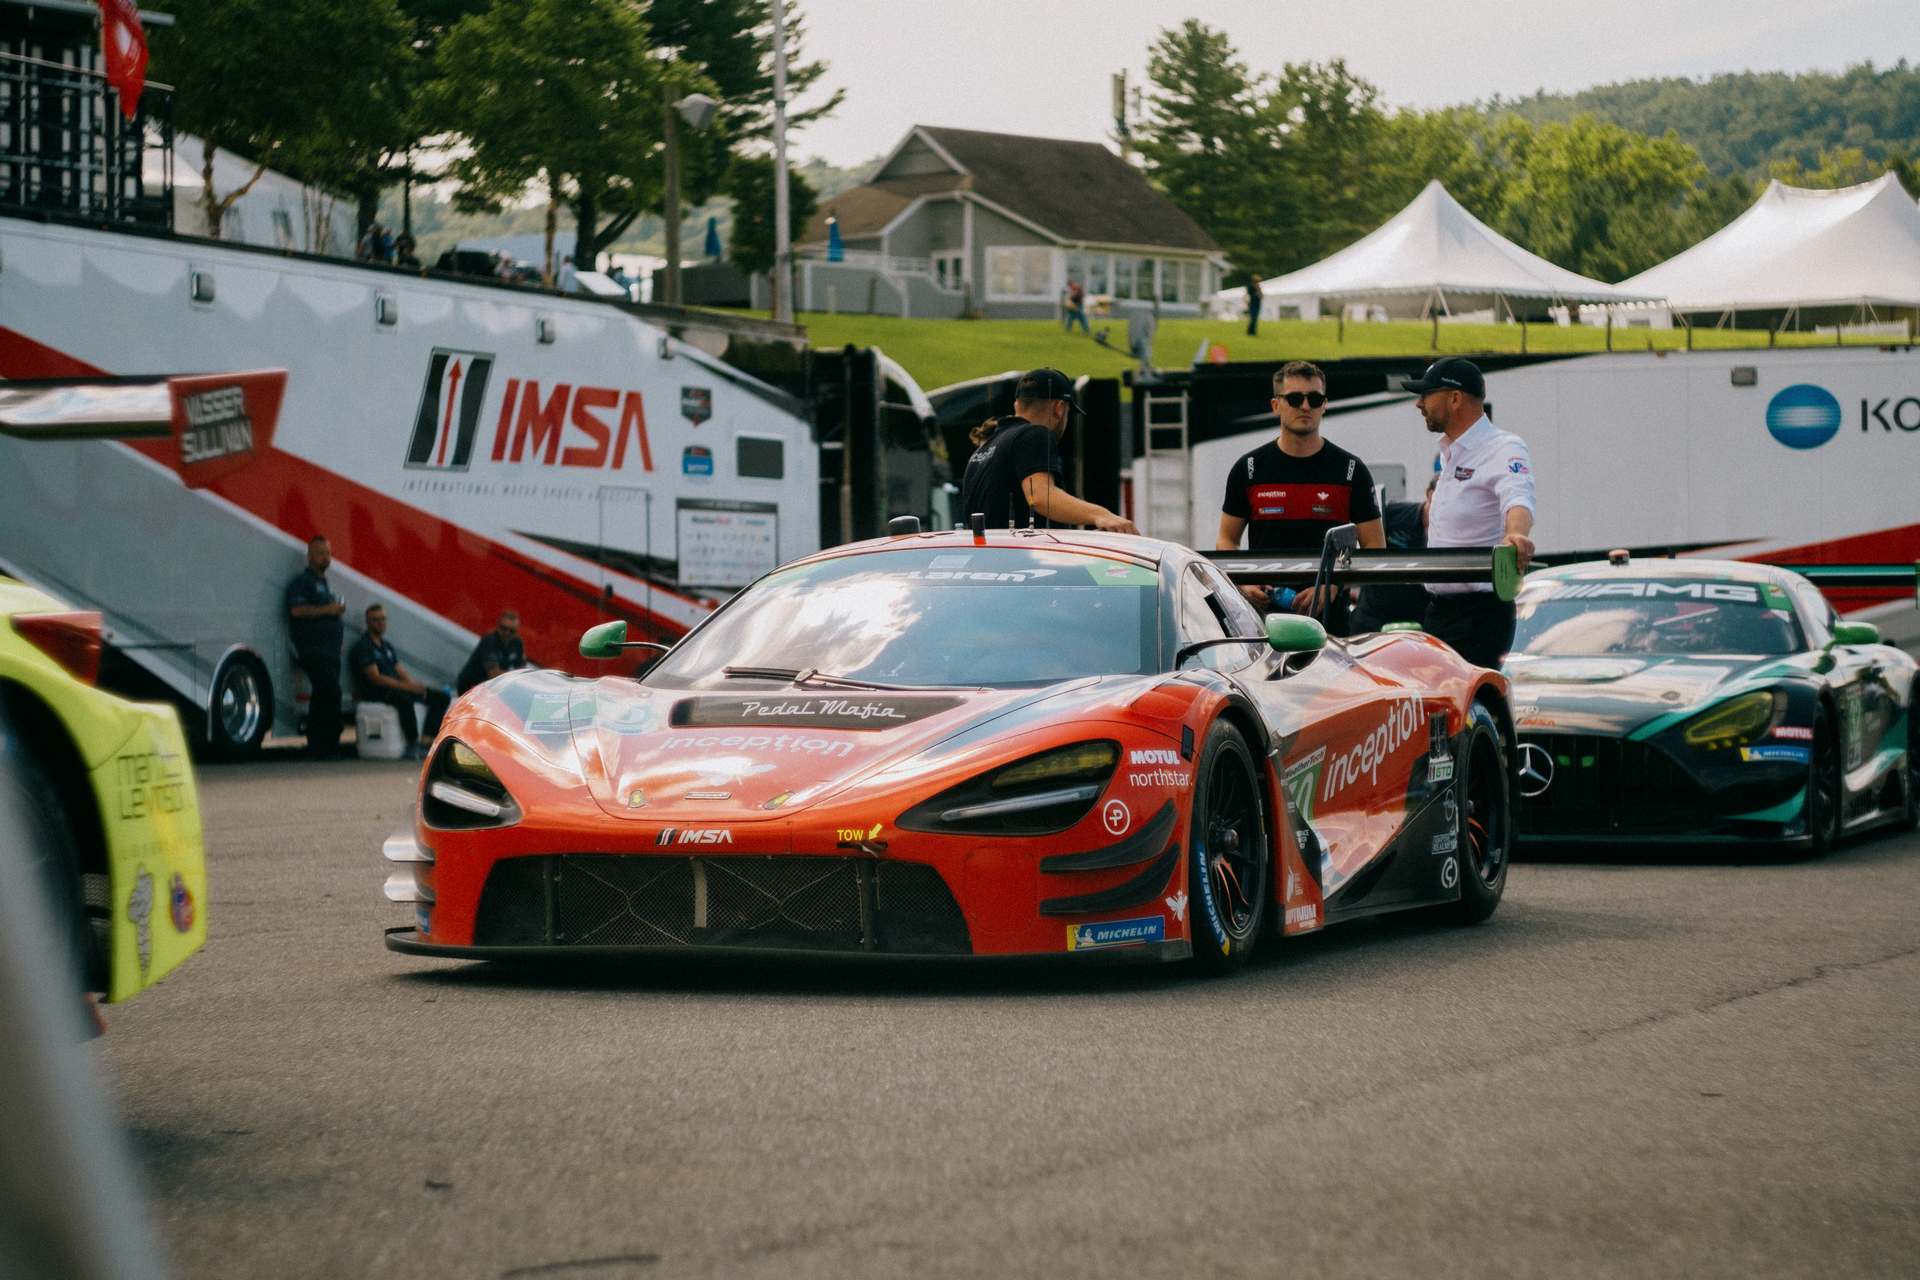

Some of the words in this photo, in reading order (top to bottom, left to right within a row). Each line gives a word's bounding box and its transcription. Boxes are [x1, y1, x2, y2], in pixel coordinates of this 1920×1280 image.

[1861, 397, 1920, 433] KO
[491, 378, 654, 473] IMSA
[1589, 582, 1758, 602] AMG
[741, 700, 816, 718] Pedal
[818, 699, 906, 719] Mafia
[658, 732, 856, 757] inception
[1323, 690, 1425, 803] inception
[1130, 750, 1181, 765] MOTUL
[678, 828, 734, 845] IMSA
[837, 829, 864, 842] TOW
[1096, 924, 1158, 941] MICHELIN
